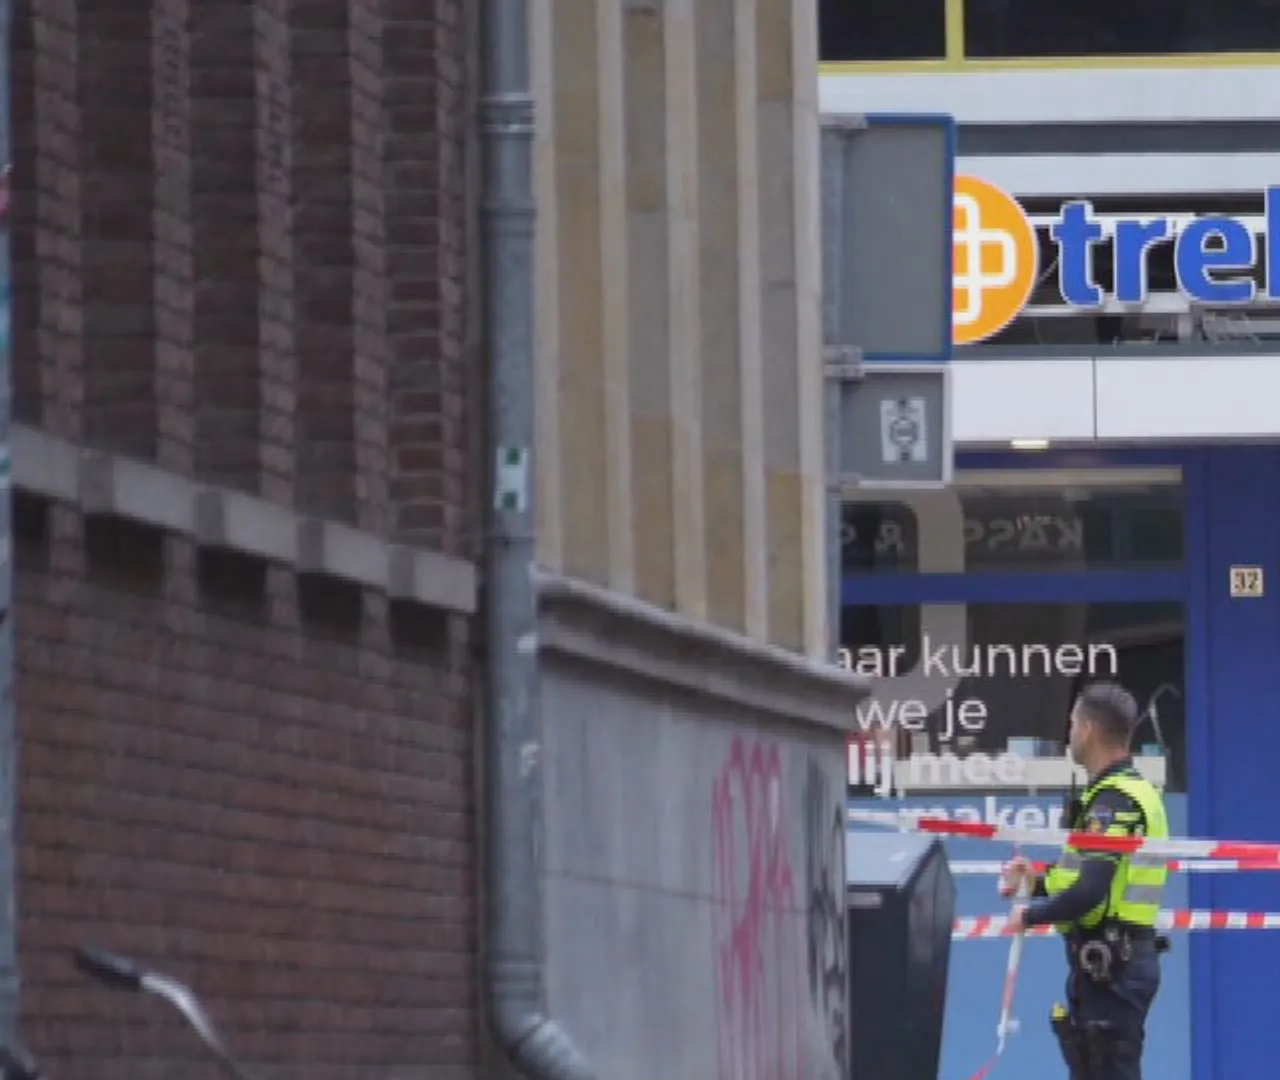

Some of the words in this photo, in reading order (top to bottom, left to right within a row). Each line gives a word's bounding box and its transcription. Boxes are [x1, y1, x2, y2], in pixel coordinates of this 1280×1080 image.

[1234, 571, 1259, 590] 32
[923, 635, 1118, 677] kunnen
[855, 698, 928, 731] we
[938, 688, 988, 741] je
